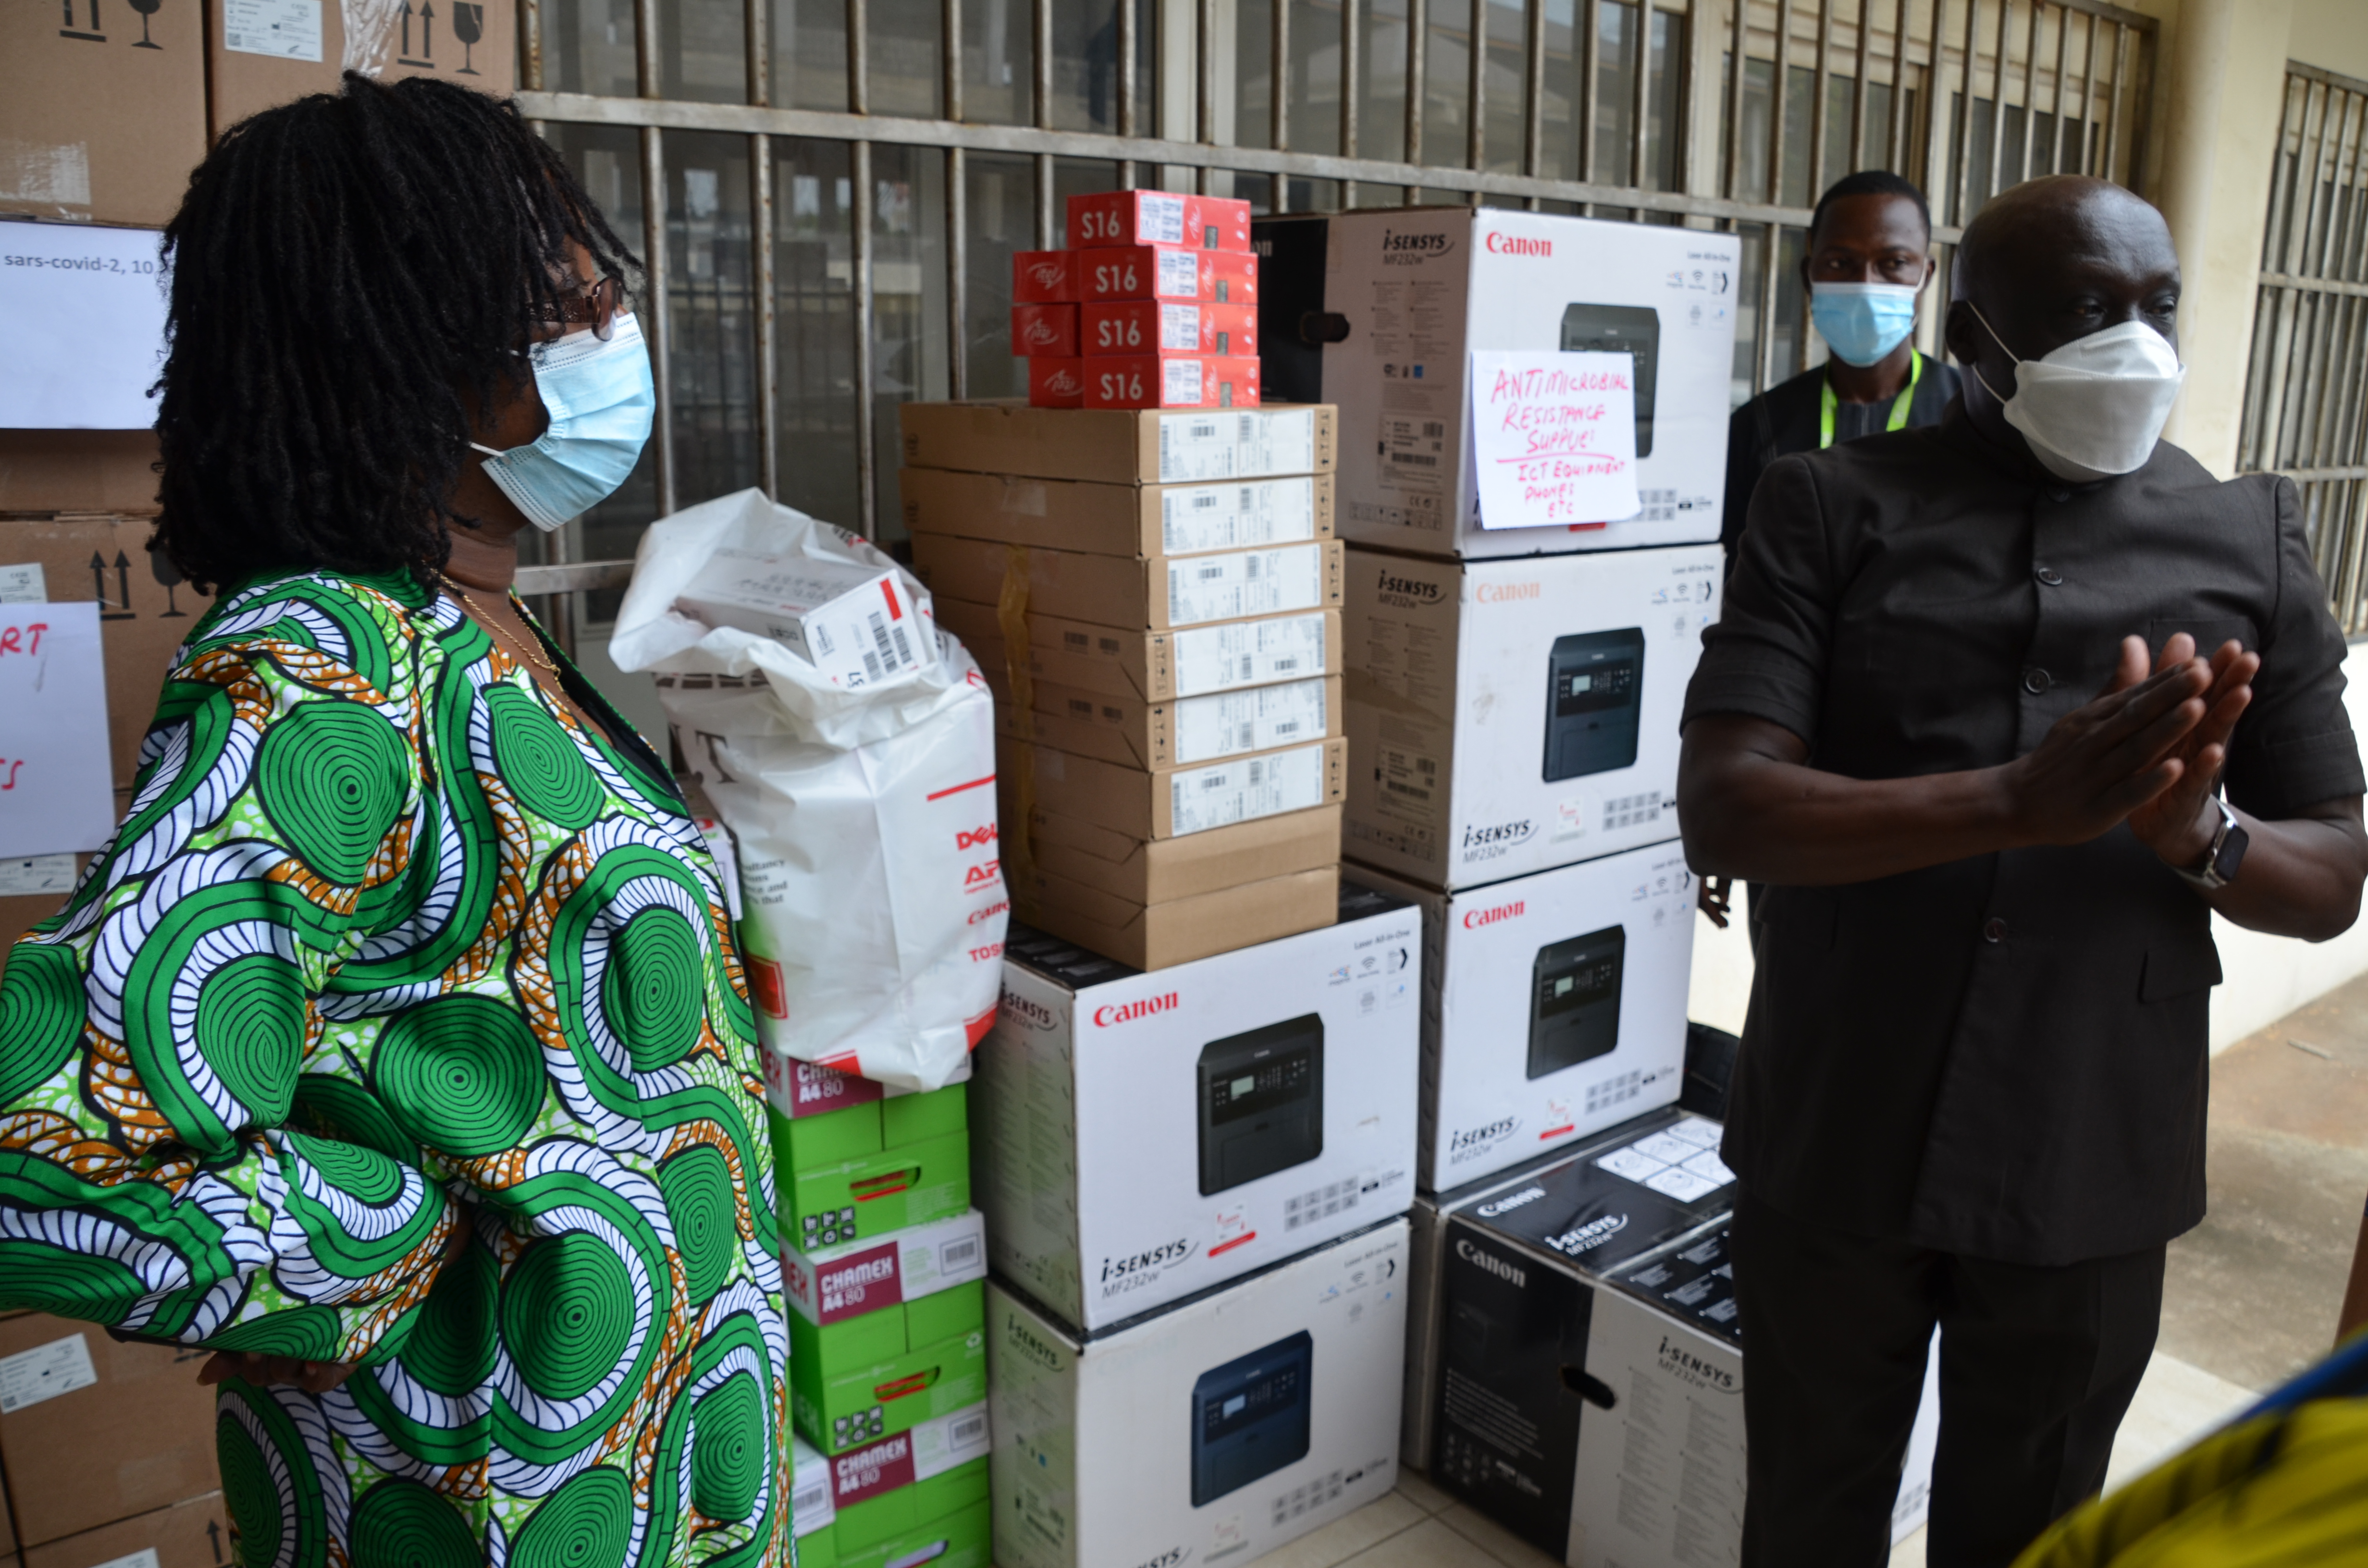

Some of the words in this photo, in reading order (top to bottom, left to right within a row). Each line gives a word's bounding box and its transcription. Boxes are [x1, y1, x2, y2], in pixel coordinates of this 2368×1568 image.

[1082, 211, 1120, 239] S16
[1383, 229, 1446, 252] i-SENSYS
[1486, 231, 1552, 257] Canon
[4, 255, 125, 275] sars-covid-2,
[132, 260, 154, 274] 10
[1096, 265, 1137, 293] S16
[1098, 320, 1141, 347] S16
[1100, 374, 1143, 401] S16
[1491, 368, 1628, 404] ANTIMICROBIAL
[1502, 402, 1605, 431] RESISTANCE
[1517, 463, 1548, 481] ICT
[1547, 499, 1573, 518] ETC
[1378, 570, 1438, 599] i-SENSYS
[1476, 582, 1541, 604] Canon
[1463, 819, 1531, 849] i-SENSYS
[1463, 900, 1525, 930] Canon
[1093, 991, 1180, 1028] Canon
[799, 1083, 822, 1103] A4
[823, 1078, 844, 1098] 80
[1450, 1116, 1514, 1152] i-SENSYS
[1477, 1186, 1547, 1217] Canon
[1100, 1237, 1187, 1283] i-SENSYS
[1455, 1238, 1527, 1288] Canon
[821, 1256, 894, 1294] CHAMEX
[822, 1292, 844, 1313] A4
[845, 1286, 864, 1305] 80
[1658, 1336, 1734, 1388] i-SENSYS
[837, 1437, 907, 1478] CHAMEX
[839, 1472, 860, 1495] A4
[860, 1467, 880, 1487] 80
